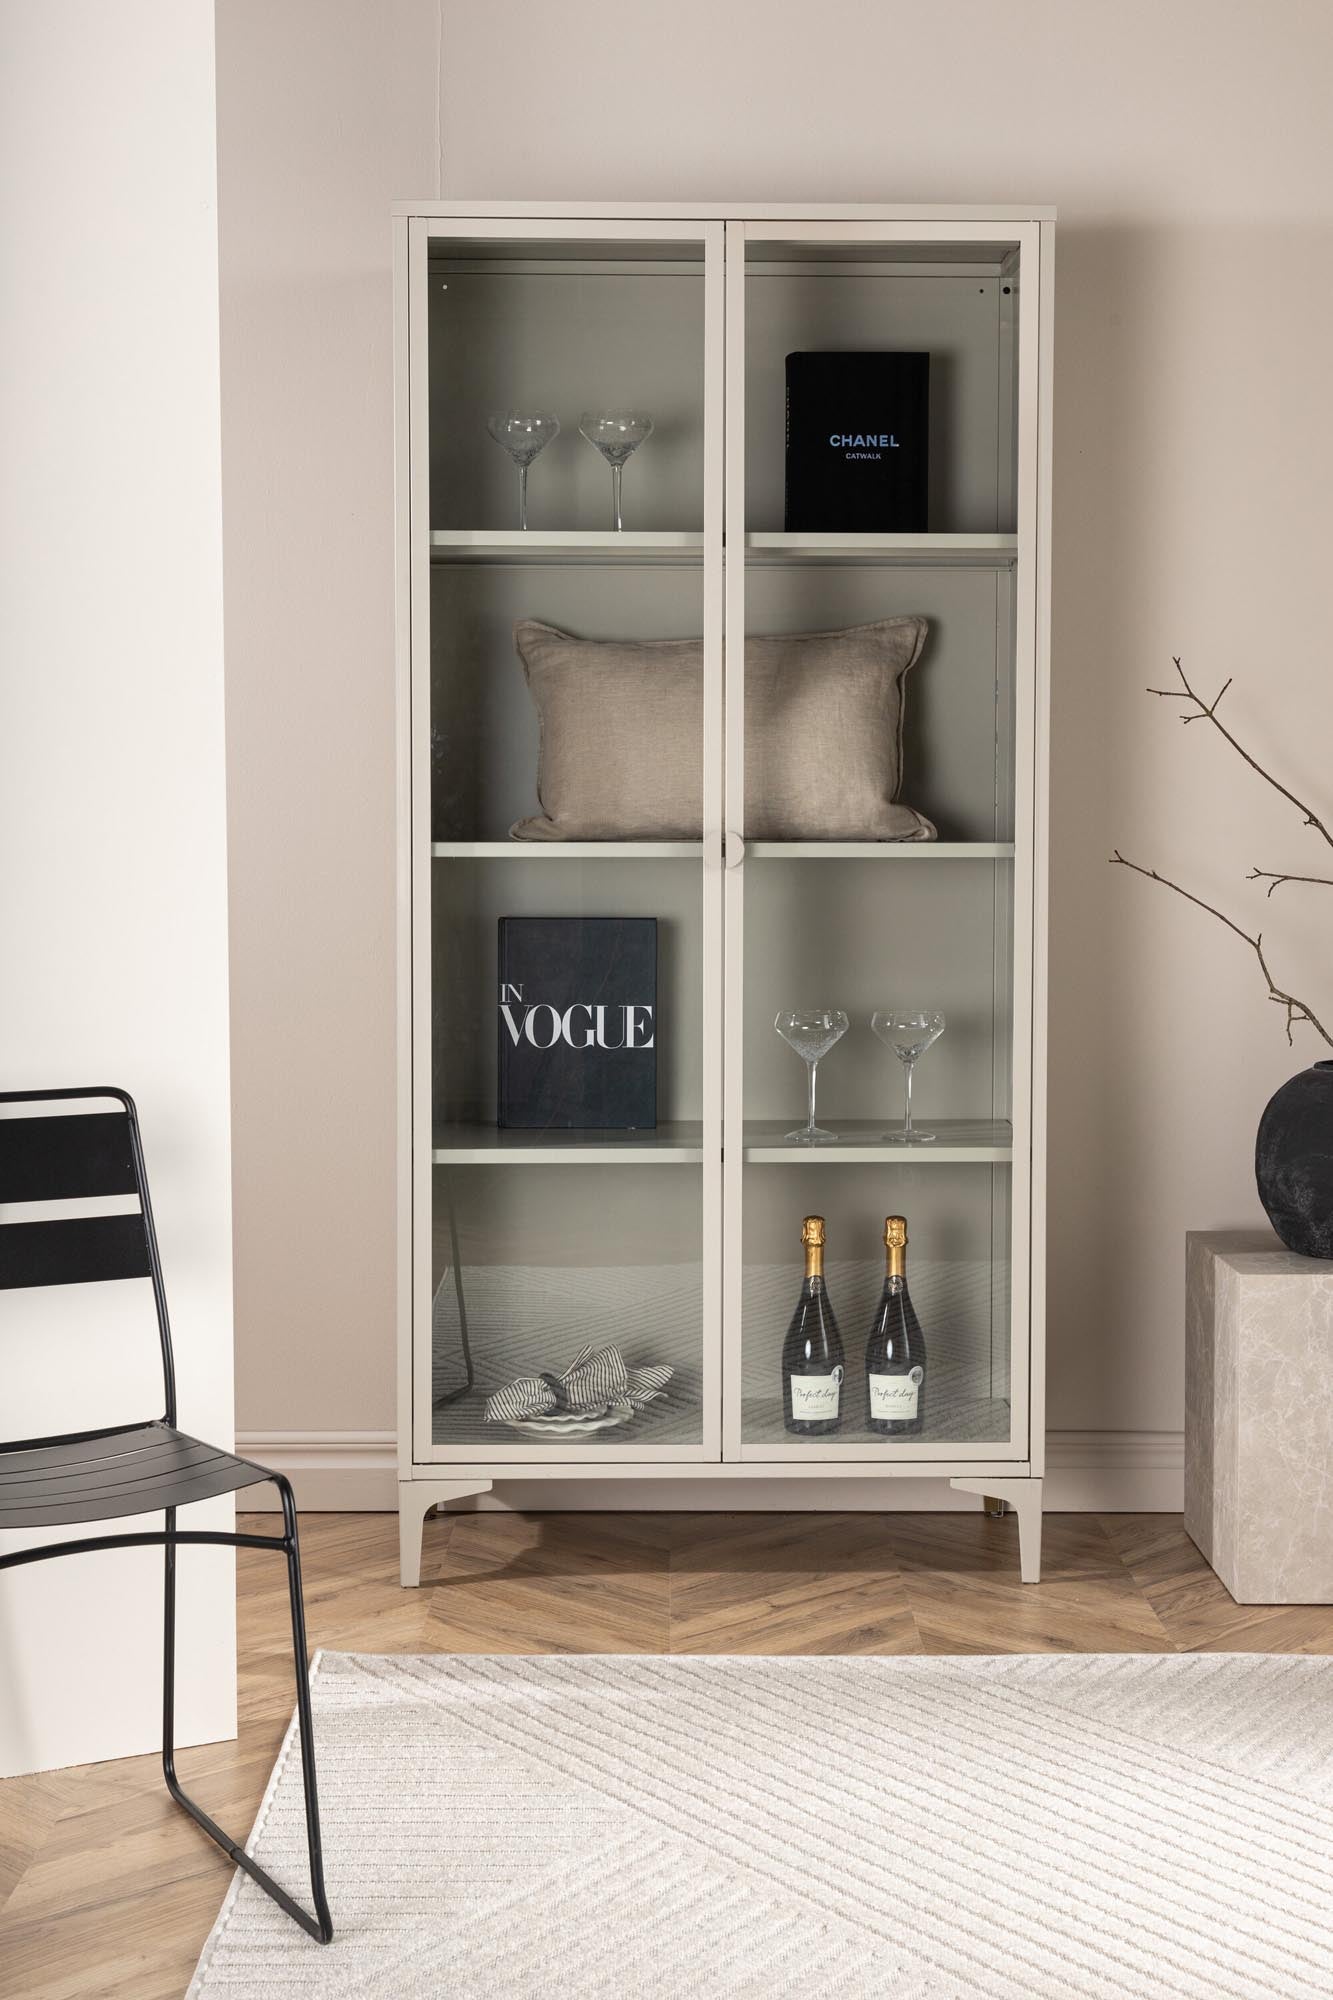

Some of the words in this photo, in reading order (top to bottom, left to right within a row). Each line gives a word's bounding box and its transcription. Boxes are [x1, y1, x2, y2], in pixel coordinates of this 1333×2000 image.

[830, 434, 899, 447] CHANEL
[845, 452, 881, 460] CATWALK
[499, 983, 524, 1003] IN
[498, 1003, 654, 1049] VOGUE
[794, 1387, 821, 1402] Perfect
[821, 1388, 837, 1401] day
[872, 1387, 898, 1401] Perfect
[898, 1388, 914, 1401] day
